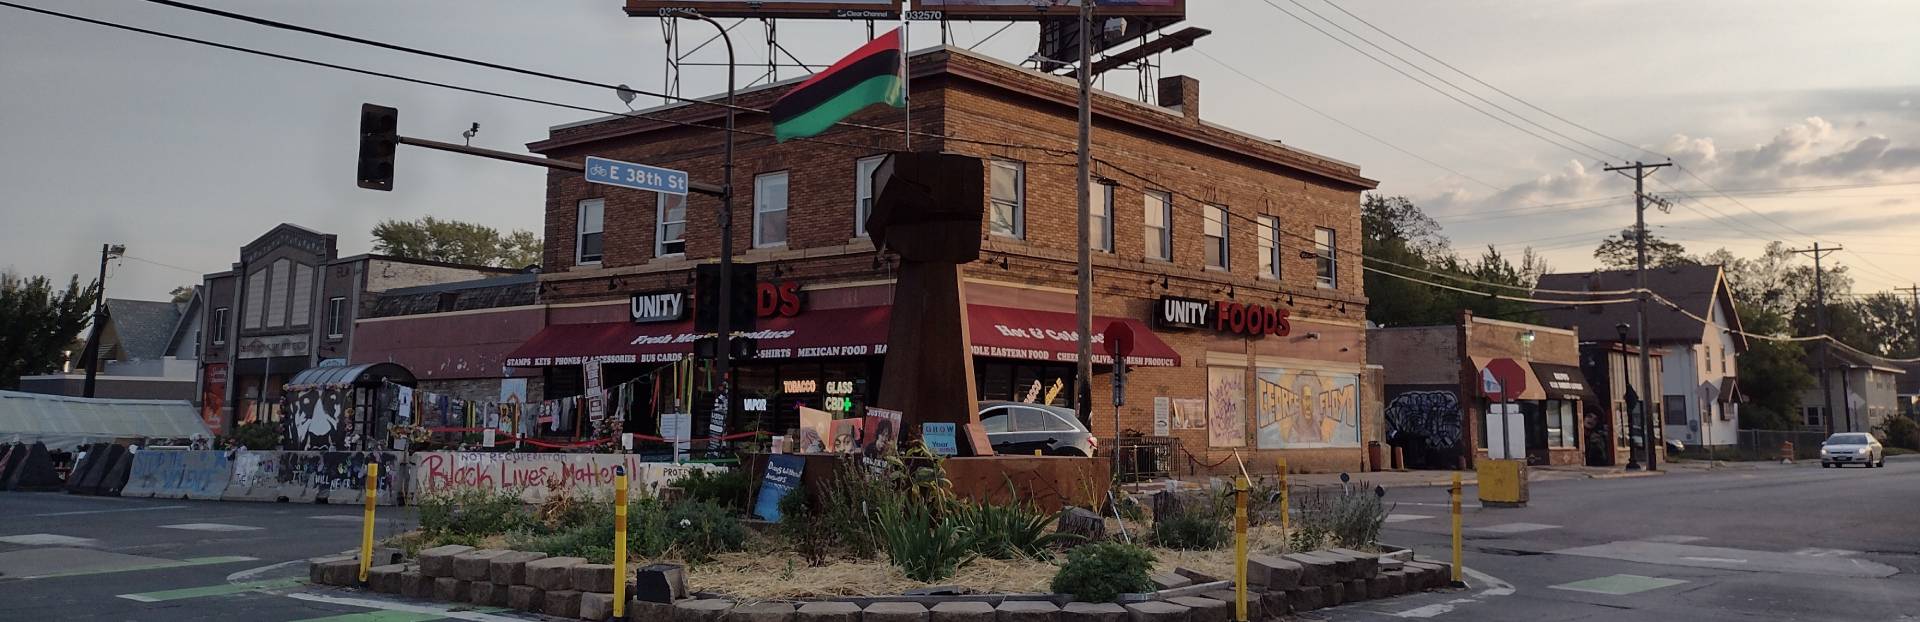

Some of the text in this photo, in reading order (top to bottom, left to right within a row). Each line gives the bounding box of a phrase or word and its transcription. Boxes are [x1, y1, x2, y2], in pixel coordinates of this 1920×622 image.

[905, 10, 942, 20] 032570
[610, 165, 684, 190] E 38th St
[632, 292, 682, 319] UNITY
[1164, 299, 1208, 325] UNITY
[1214, 300, 1290, 337] FOODS
[797, 346, 840, 358] MEXICAN
[841, 344, 868, 356] FOOD
[990, 346, 1026, 359] EASTERN
[1027, 349, 1050, 361] FOOD
[1123, 356, 1143, 366] RESH
[1144, 357, 1175, 367] PRODUCE
[507, 357, 532, 366] STAMPS
[534, 357, 551, 366] KEYS
[554, 356, 581, 365] PHONES
[641, 354, 656, 363] BUS
[657, 353, 683, 362] CARDS
[784, 380, 816, 393] TOBACCO
[826, 381, 853, 394] GLASS
[744, 398, 767, 411] VAPOR
[461, 452, 483, 462] NOT
[421, 454, 493, 492] Black
[502, 460, 550, 489] Lives
